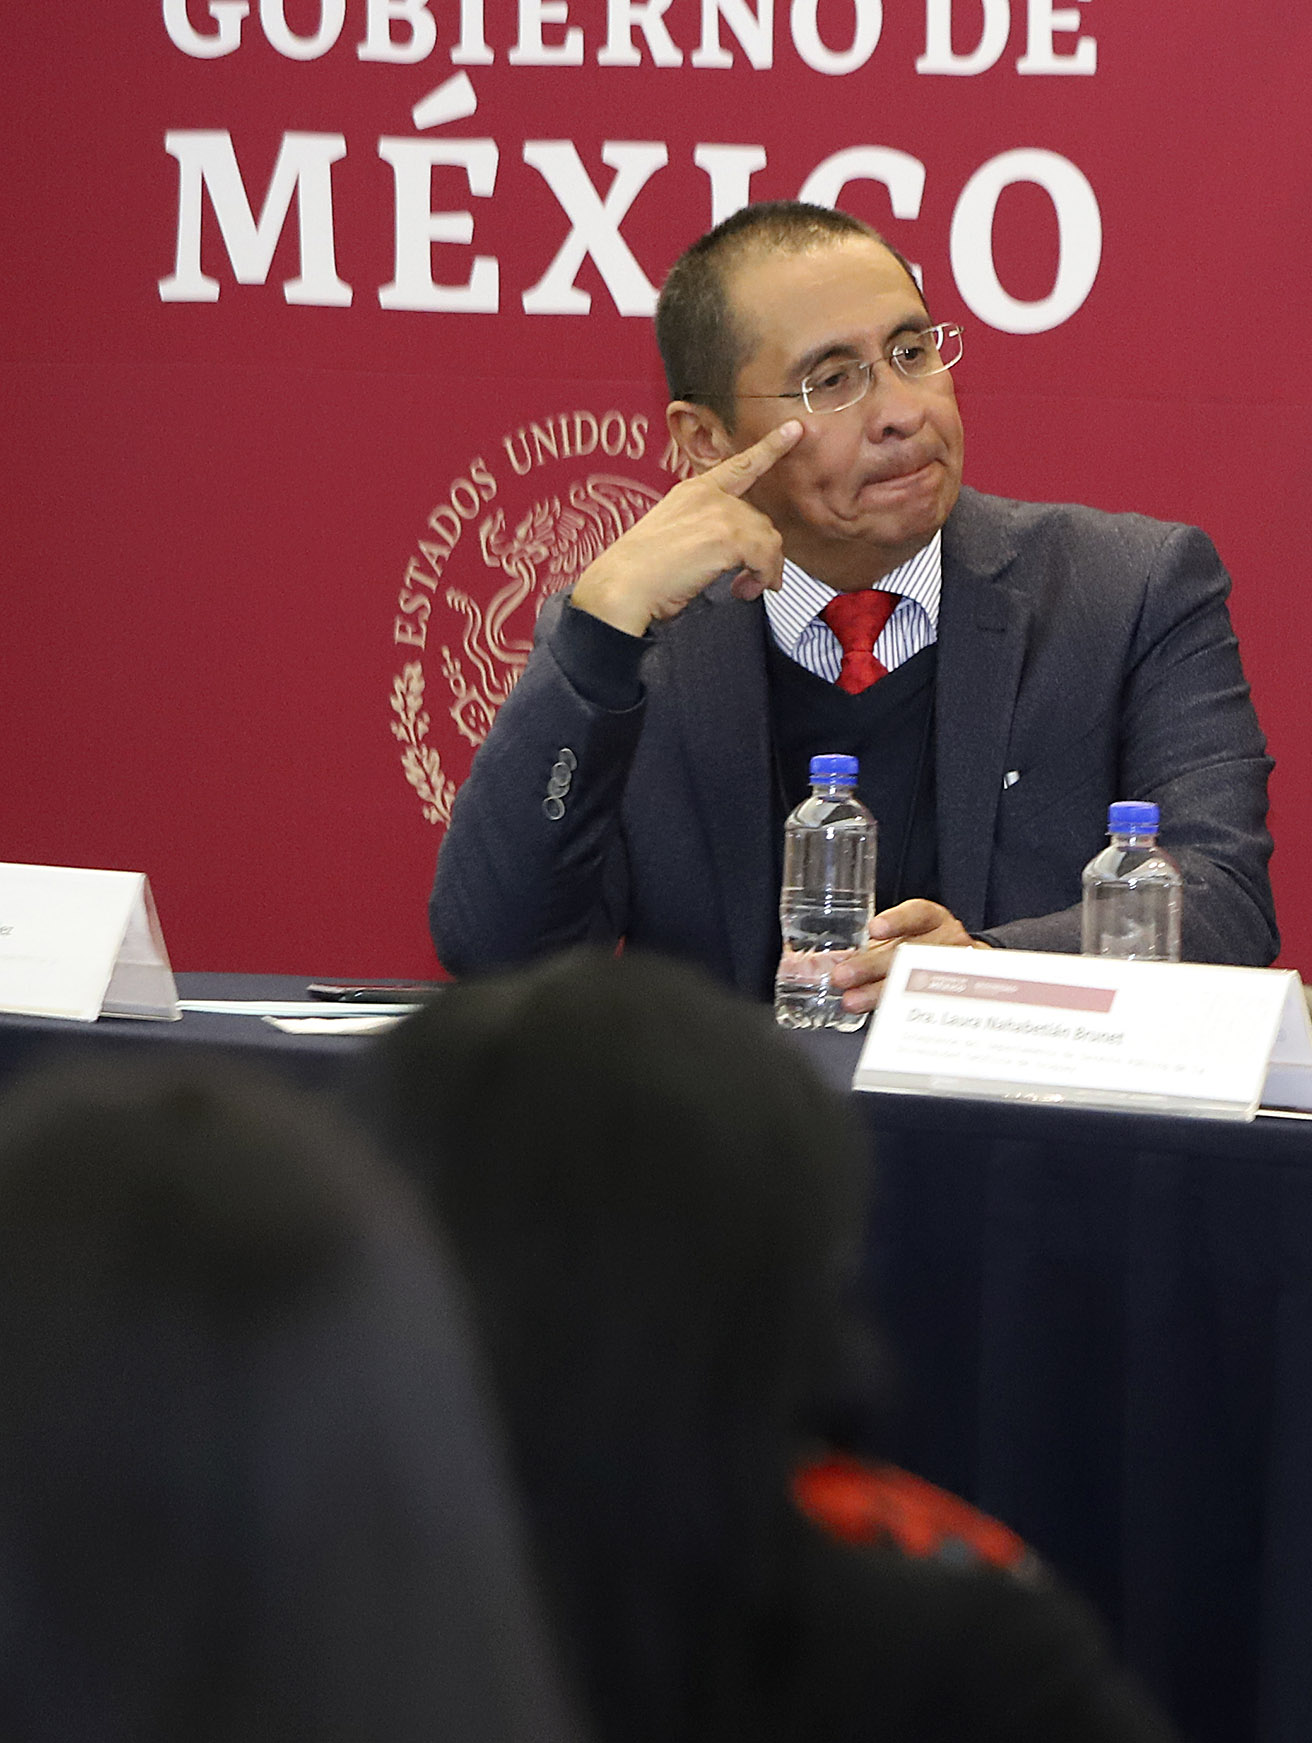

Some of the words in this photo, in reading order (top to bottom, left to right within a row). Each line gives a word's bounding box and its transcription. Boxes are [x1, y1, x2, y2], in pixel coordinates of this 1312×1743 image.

[161, 0, 884, 76] GOBIERNO
[915, 0, 1098, 77] DE
[394, 456, 498, 651] ESTADOS
[502, 410, 649, 476] UNIDOS
